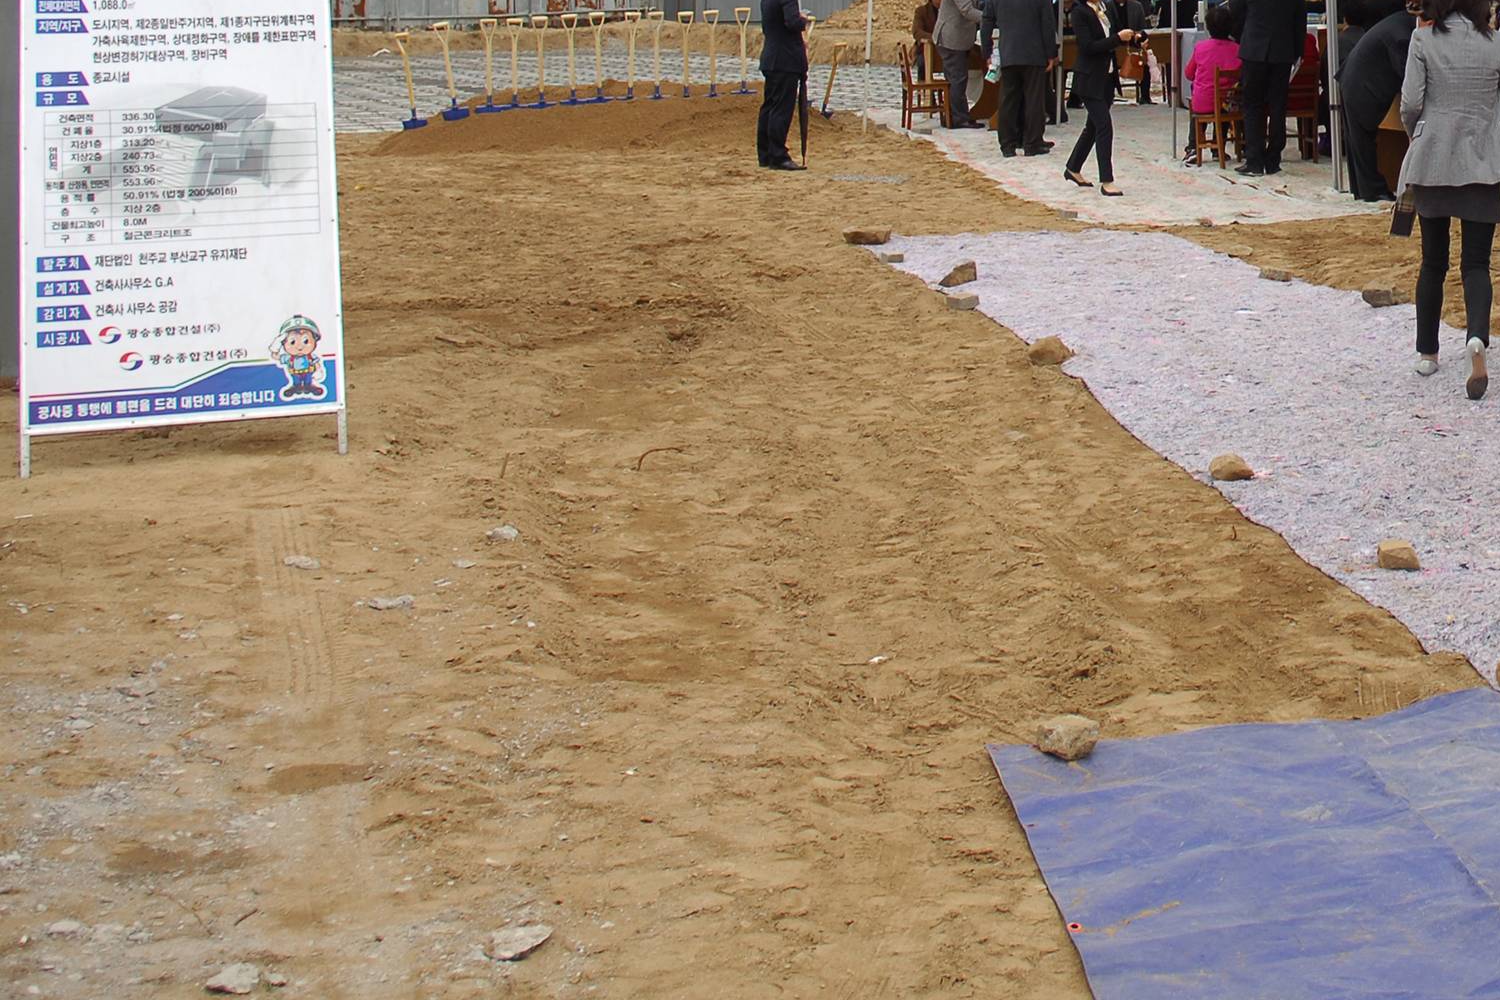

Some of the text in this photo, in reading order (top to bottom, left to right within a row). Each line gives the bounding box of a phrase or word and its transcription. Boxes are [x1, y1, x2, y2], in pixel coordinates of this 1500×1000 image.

[39, 20, 80, 32] 지역/지구
[92, 71, 130, 84] 종교시설
[44, 257, 80, 271] 발주처
[95, 248, 248, 267] 재단법인 천주교 부산교구 유지재단
[44, 282, 80, 296] 설계자
[95, 277, 174, 292] 건축사사무소 G.A
[44, 307, 80, 321] 감리자
[95, 300, 178, 317] 건축사 사무소 공감
[44, 332, 80, 346] 시공사
[38, 404, 73, 420] 공사중
[154, 396, 177, 411] 드려
[180, 393, 215, 409] 대단히
[218, 390, 275, 407] 죄송합니다
